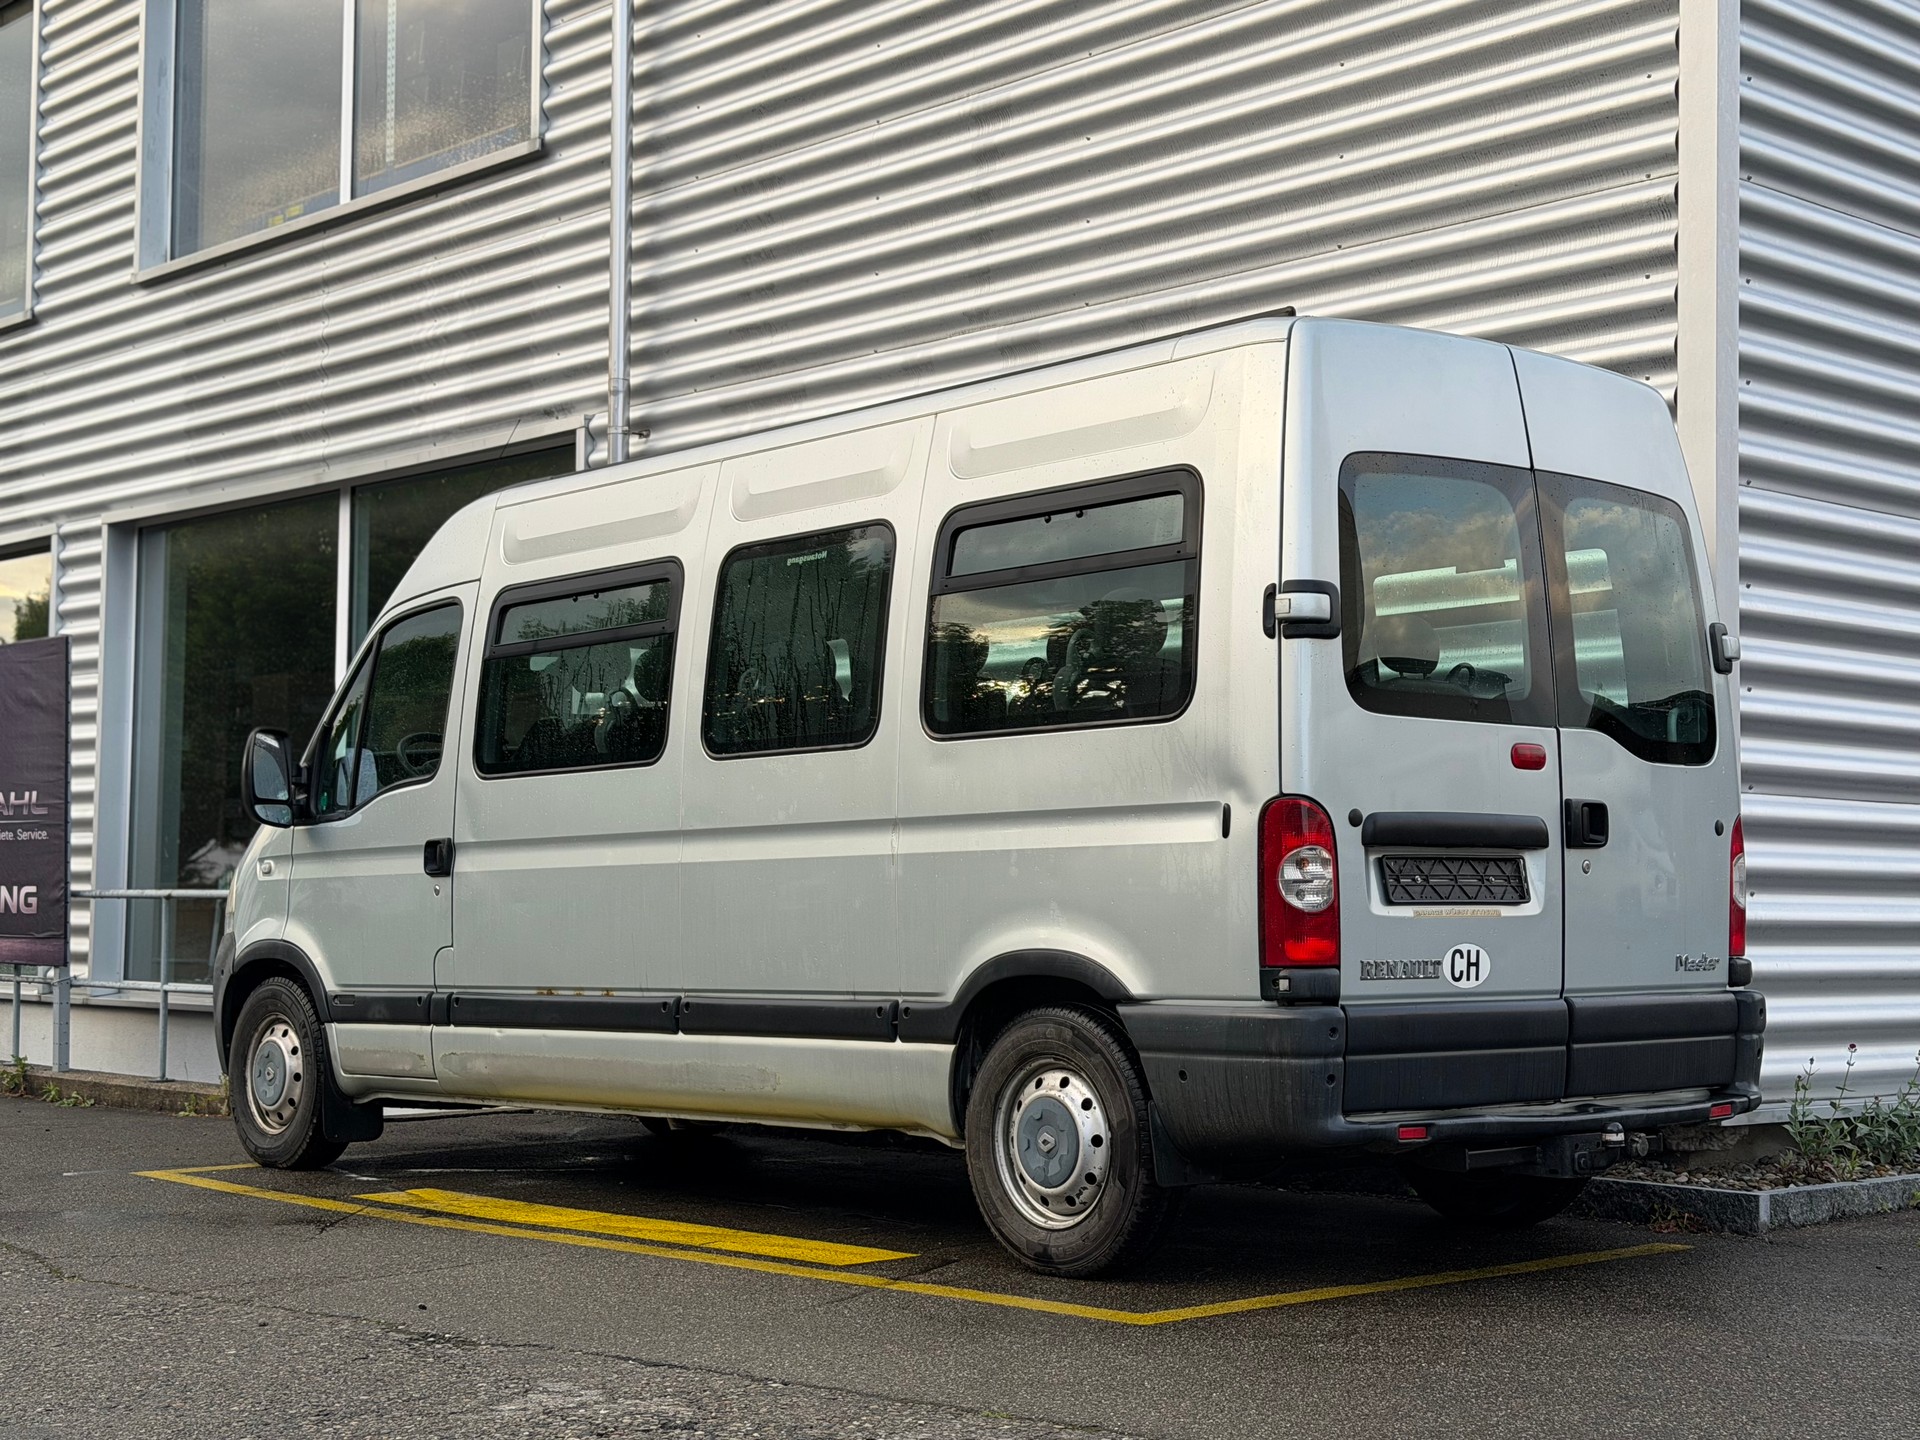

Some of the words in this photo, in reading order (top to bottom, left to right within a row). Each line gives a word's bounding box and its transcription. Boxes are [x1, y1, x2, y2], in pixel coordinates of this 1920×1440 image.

[16, 828, 49, 840] Service.
[1360, 960, 1442, 980] RENAULT
[1450, 949, 1480, 982] CH
[1675, 952, 1720, 971] Master
